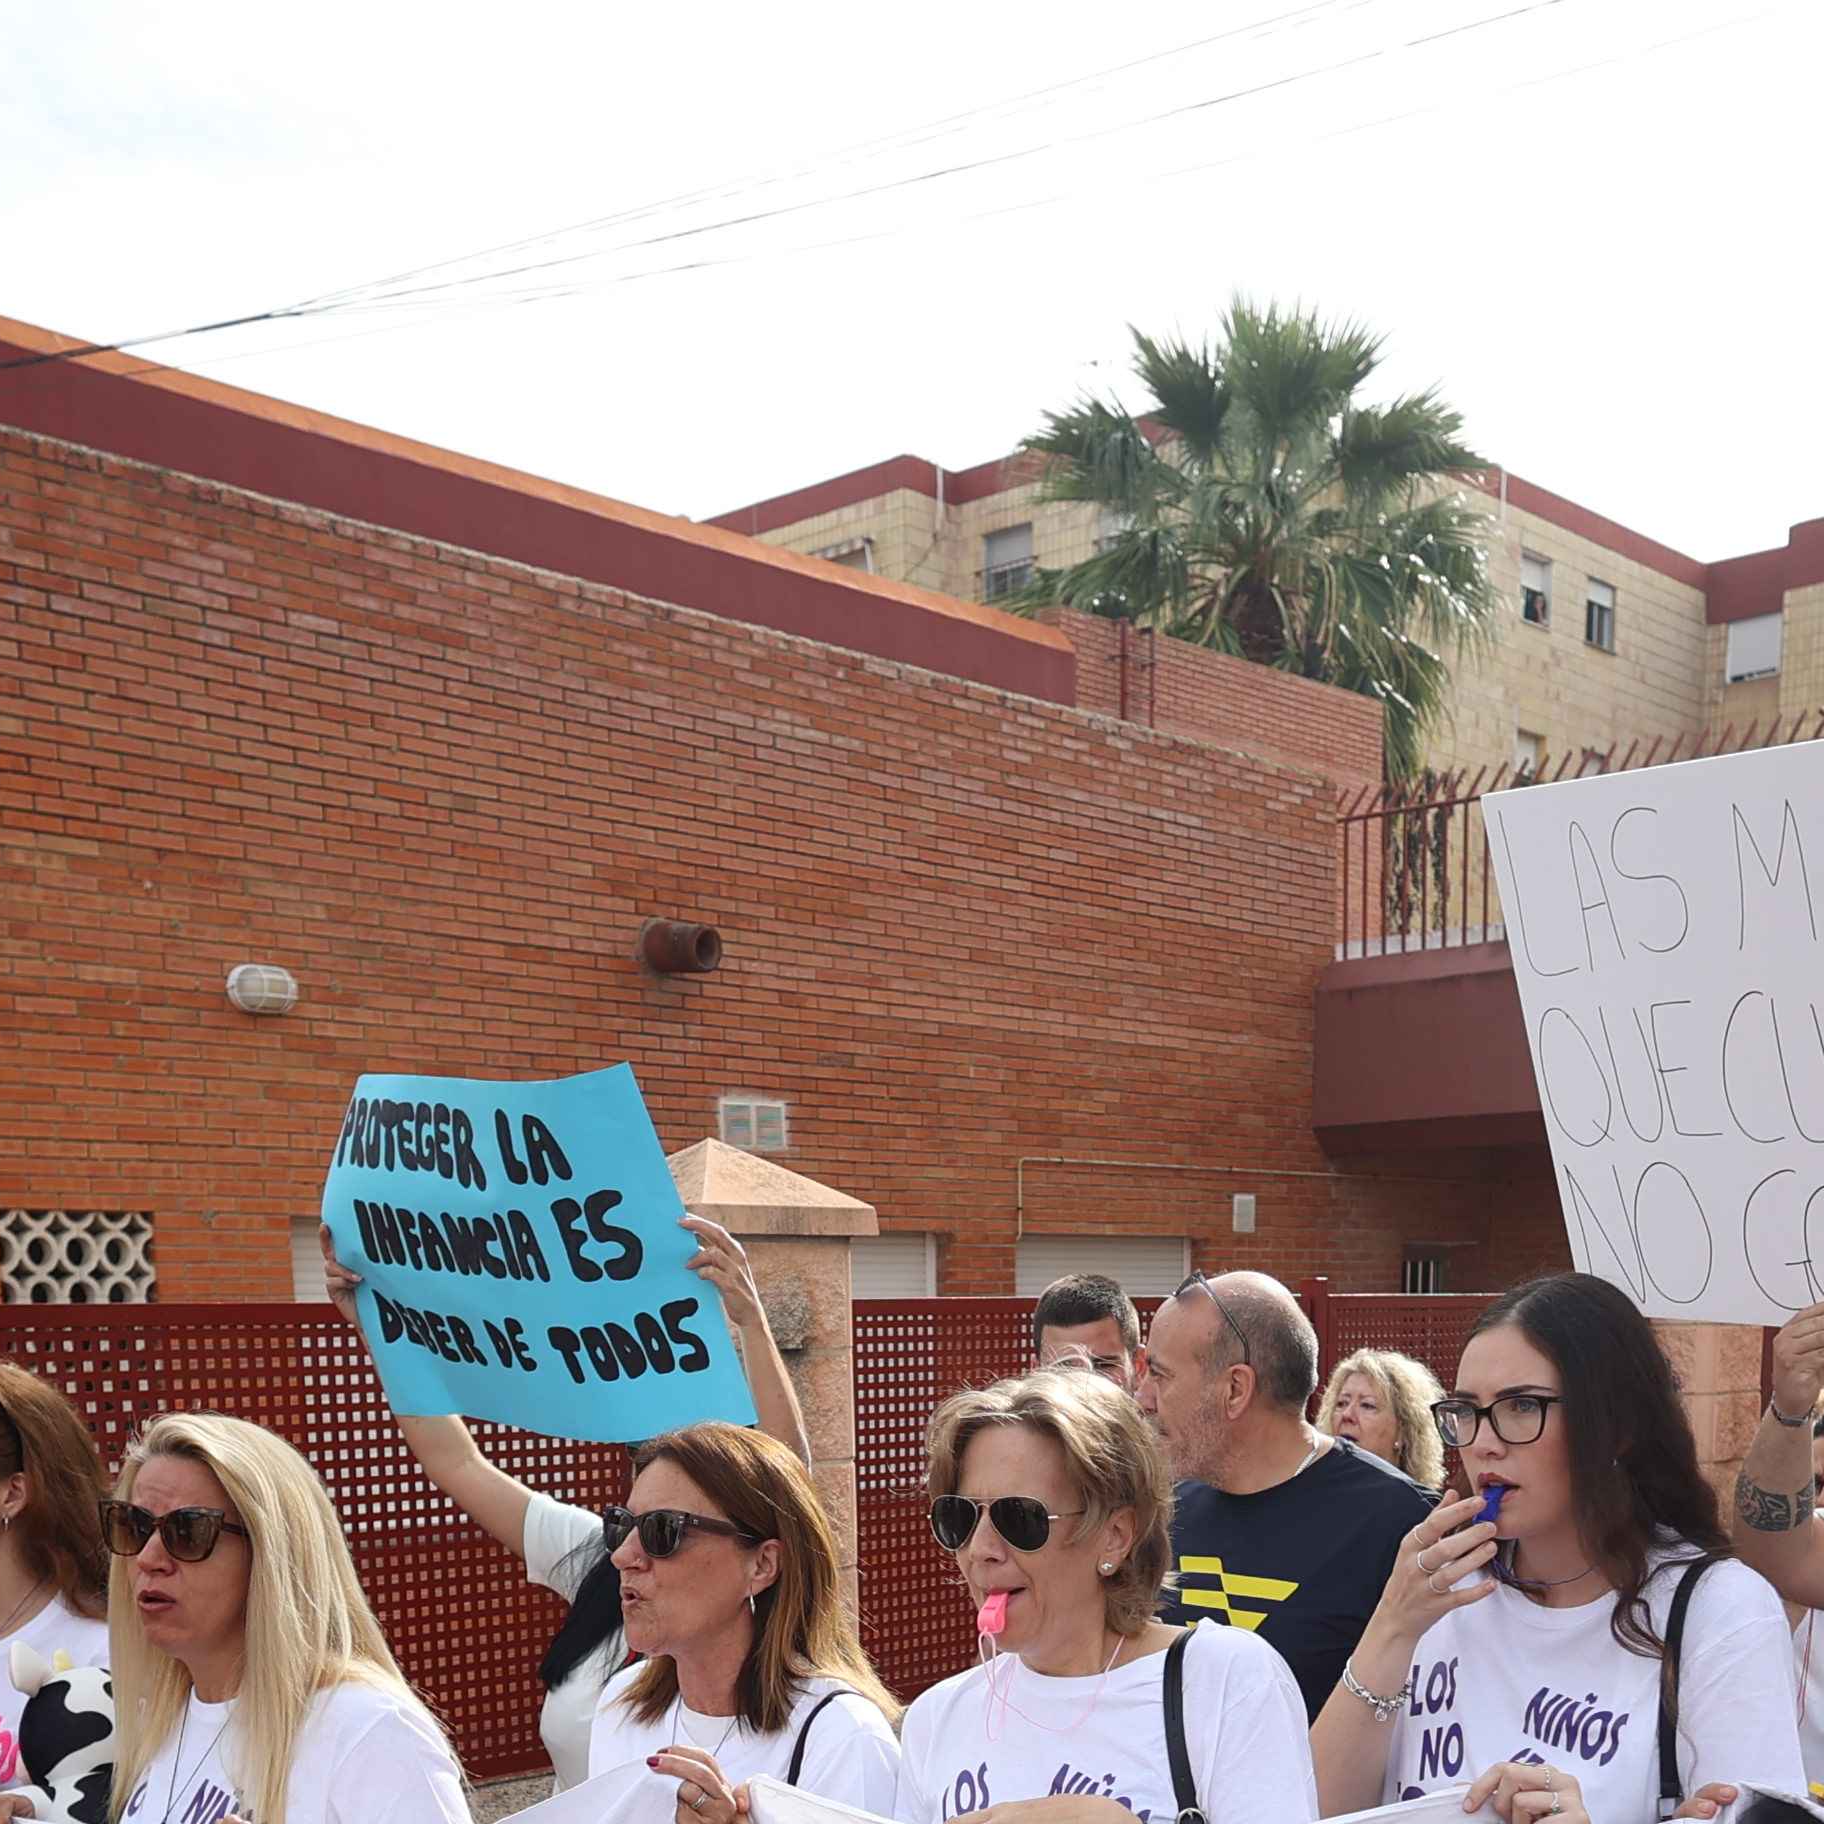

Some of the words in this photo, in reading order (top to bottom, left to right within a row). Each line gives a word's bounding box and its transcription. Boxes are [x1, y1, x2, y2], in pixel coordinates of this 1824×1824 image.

[1497, 806, 1689, 978] LAS
[1537, 998, 1724, 1148] QUE
[336, 1097, 487, 1192] PROTEGER
[494, 1106, 573, 1187] LA
[352, 1197, 551, 1284] INFANCIA
[549, 1188, 644, 1283] ES
[1564, 1159, 1715, 1305] NO
[369, 1288, 488, 1367] DEBER
[483, 1316, 538, 1373] DE
[547, 1296, 712, 1385] TODOS
[1408, 1655, 1459, 1718] LOS
[1522, 1684, 1630, 1767] NIÑOS
[1419, 1721, 1465, 1785] NO
